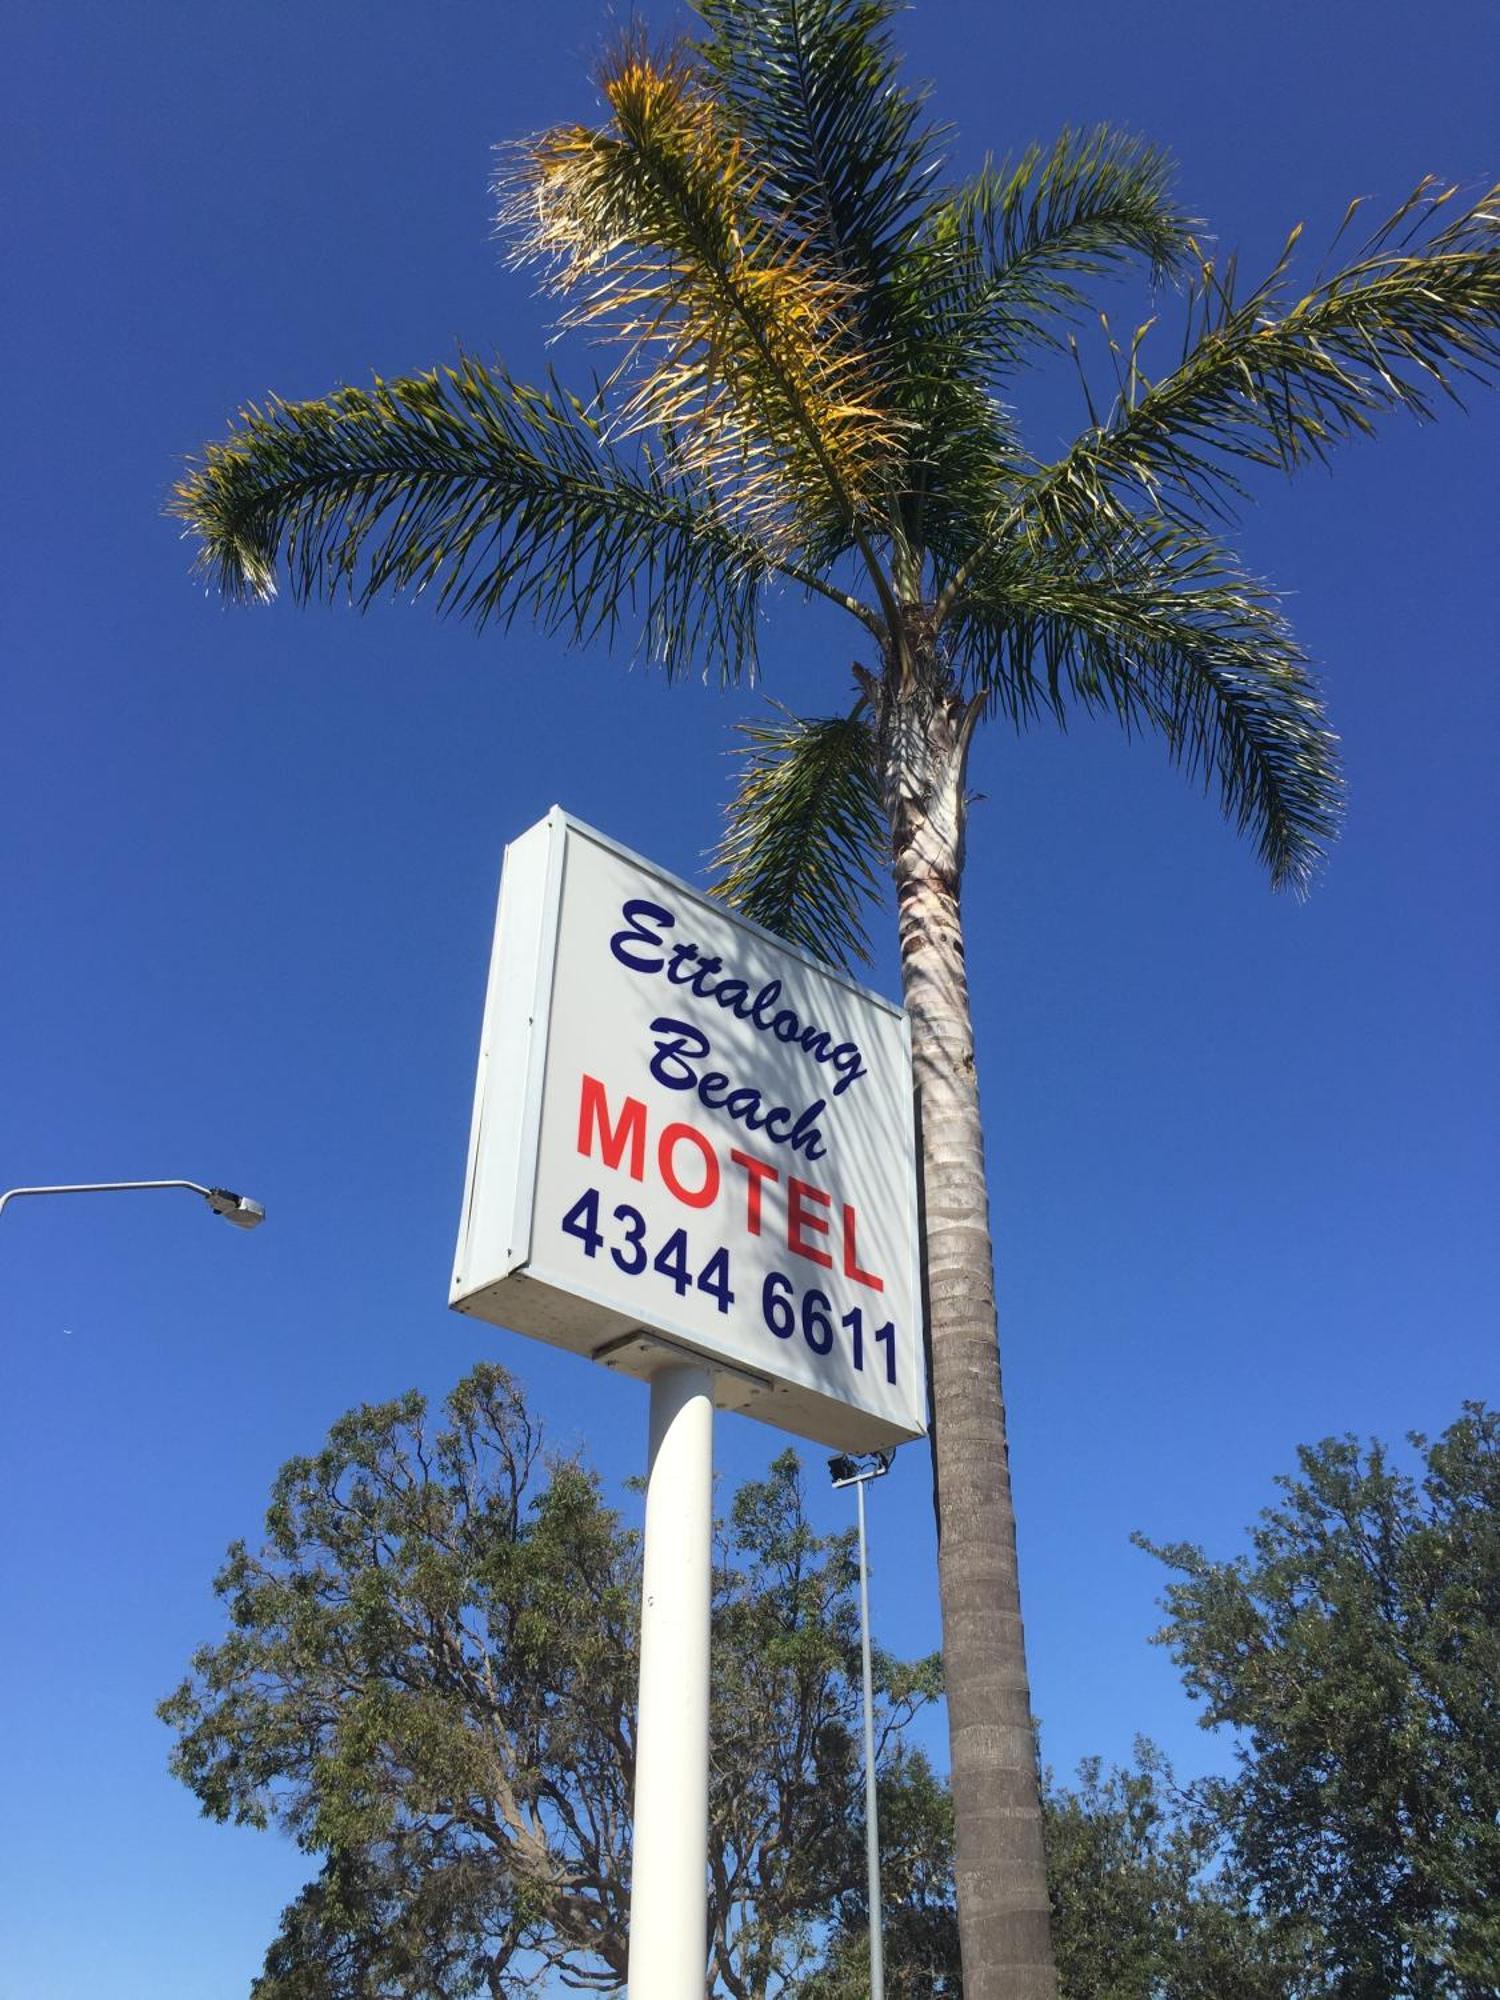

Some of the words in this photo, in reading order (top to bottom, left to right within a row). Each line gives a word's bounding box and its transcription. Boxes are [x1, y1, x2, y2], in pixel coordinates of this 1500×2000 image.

[610, 899, 868, 1095] Ettalong
[649, 1017, 827, 1160] Beach
[577, 1073, 884, 1293] MOTEL
[562, 1188, 735, 1314] 4344
[762, 1272, 896, 1385] 6611
